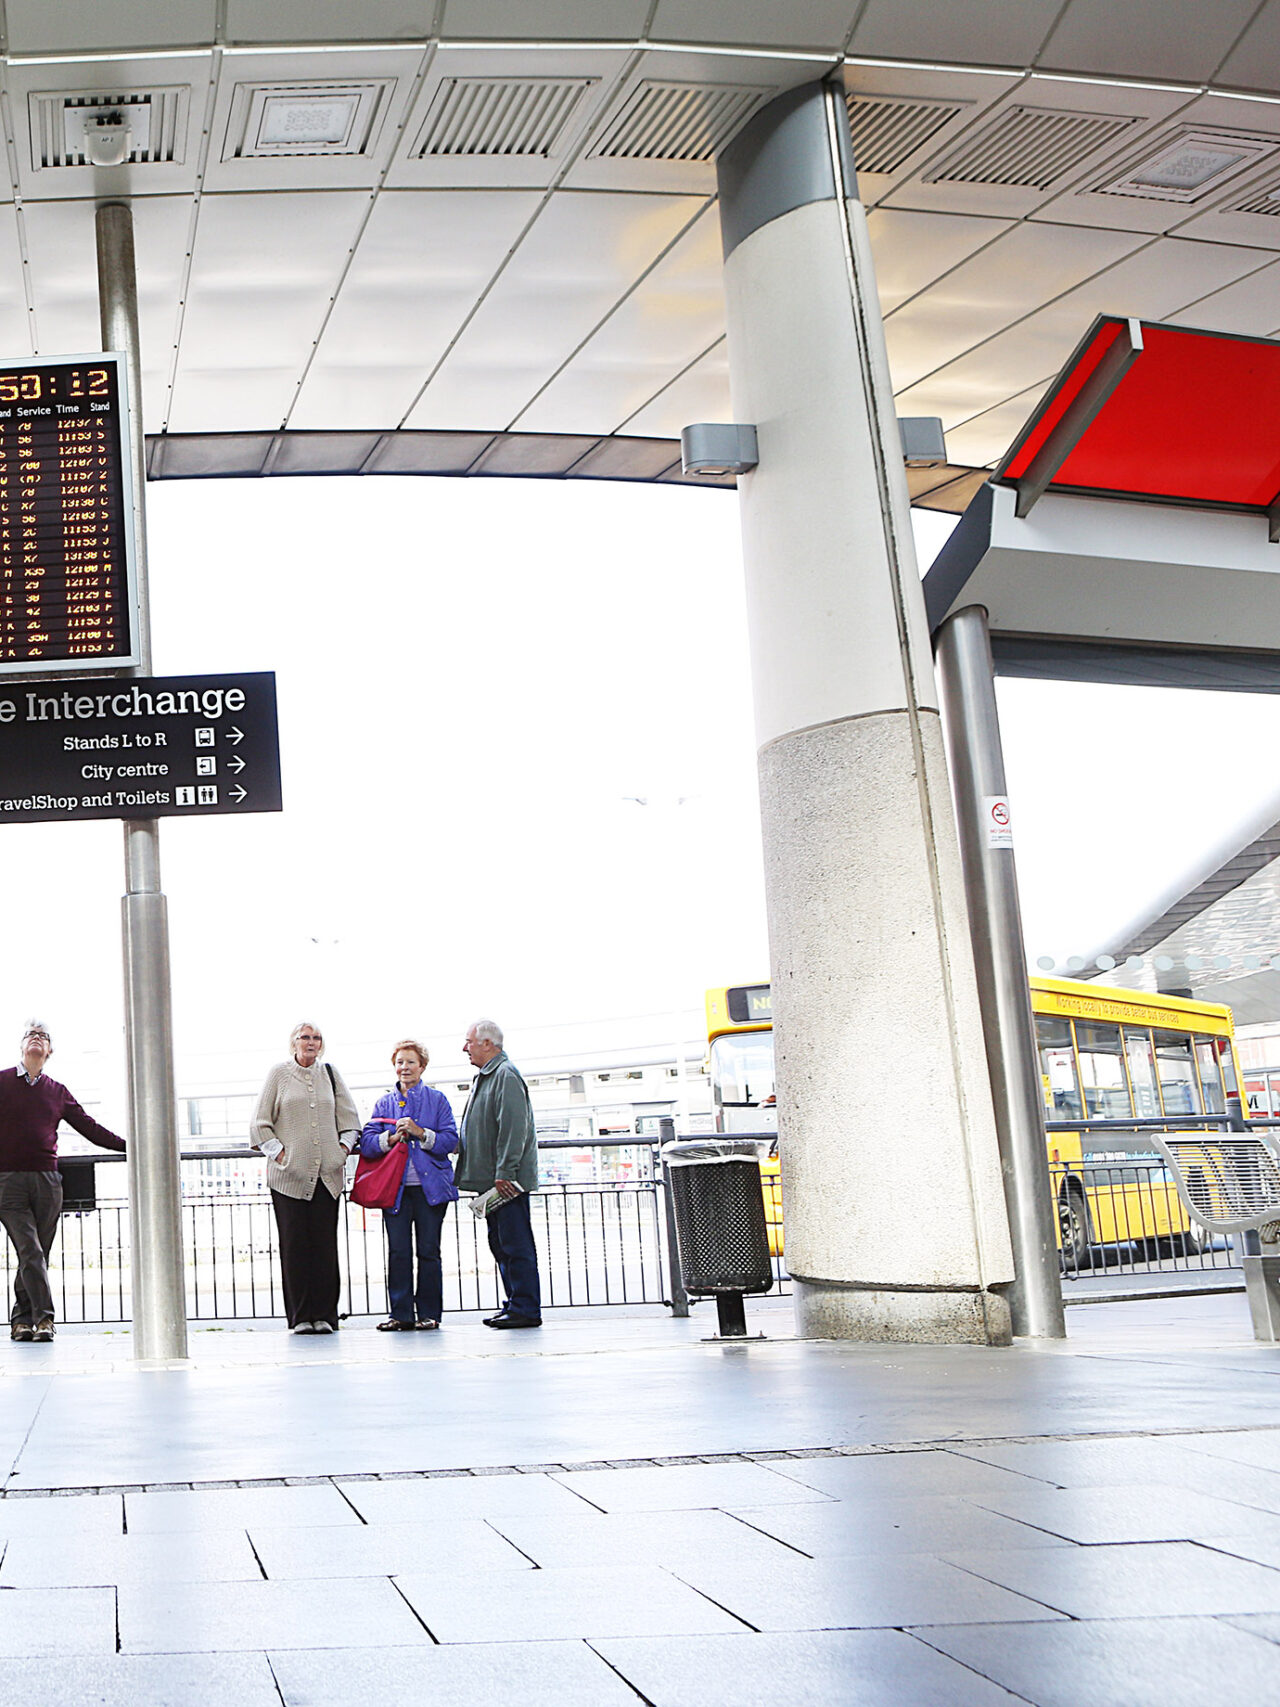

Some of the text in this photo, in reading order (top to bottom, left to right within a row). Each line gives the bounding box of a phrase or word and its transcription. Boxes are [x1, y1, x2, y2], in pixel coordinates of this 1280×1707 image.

[16, 406, 52, 417] Service
[55, 404, 80, 414] Time
[90, 401, 110, 412] Stand
[26, 687, 245, 720] Interchange
[64, 733, 167, 750] Stands L to R
[82, 763, 168, 780] City centre
[82, 793, 112, 807] and
[116, 791, 169, 805] Toilets
